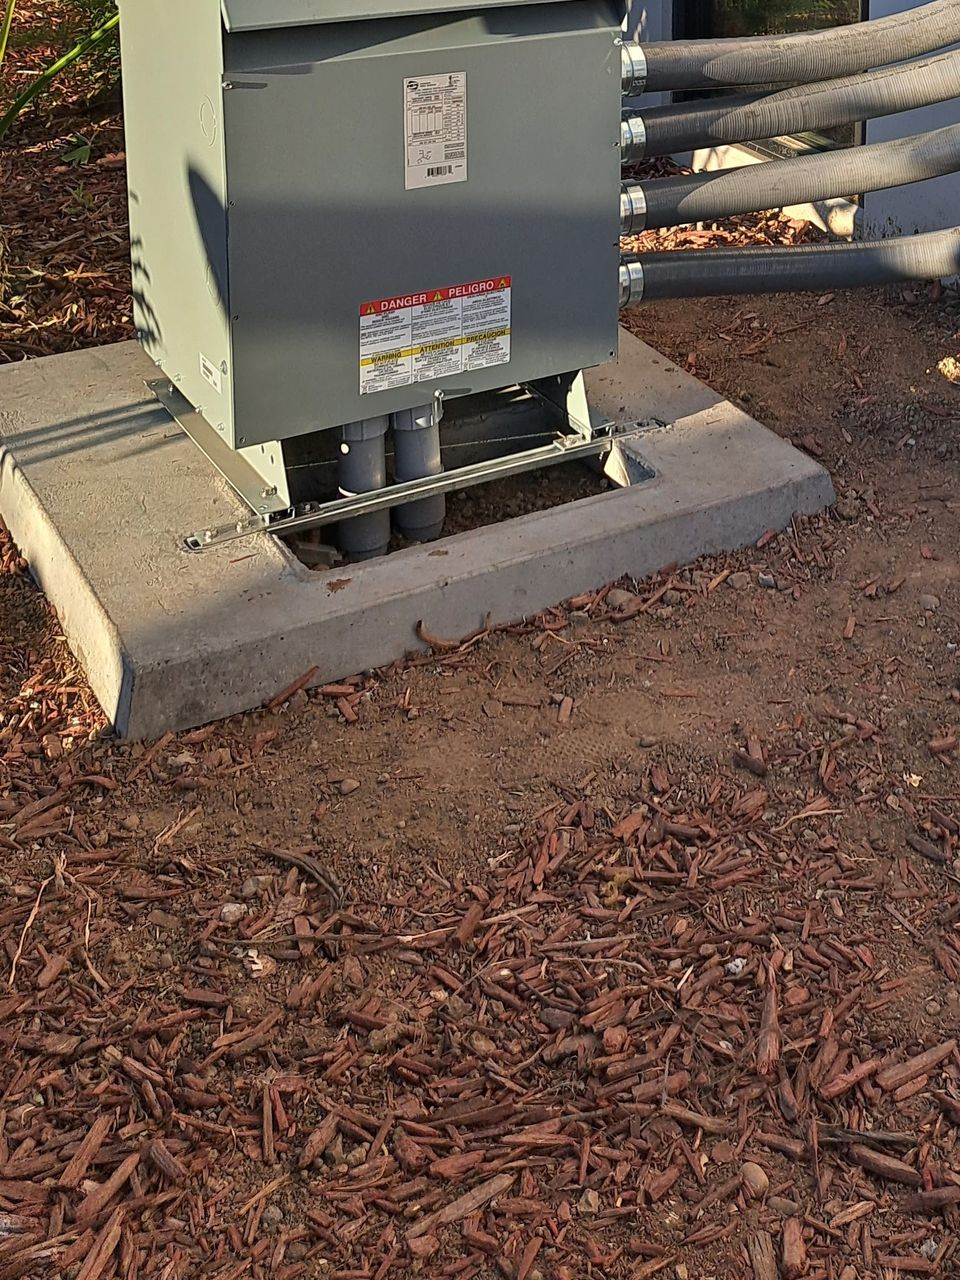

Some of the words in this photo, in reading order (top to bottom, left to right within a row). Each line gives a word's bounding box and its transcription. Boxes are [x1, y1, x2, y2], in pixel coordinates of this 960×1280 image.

[381, 294, 427, 311] DANGER
[449, 281, 494, 298] PELIGRO
[420, 340, 455, 352] ATTENTION
[371, 352, 402, 363] WARNING
